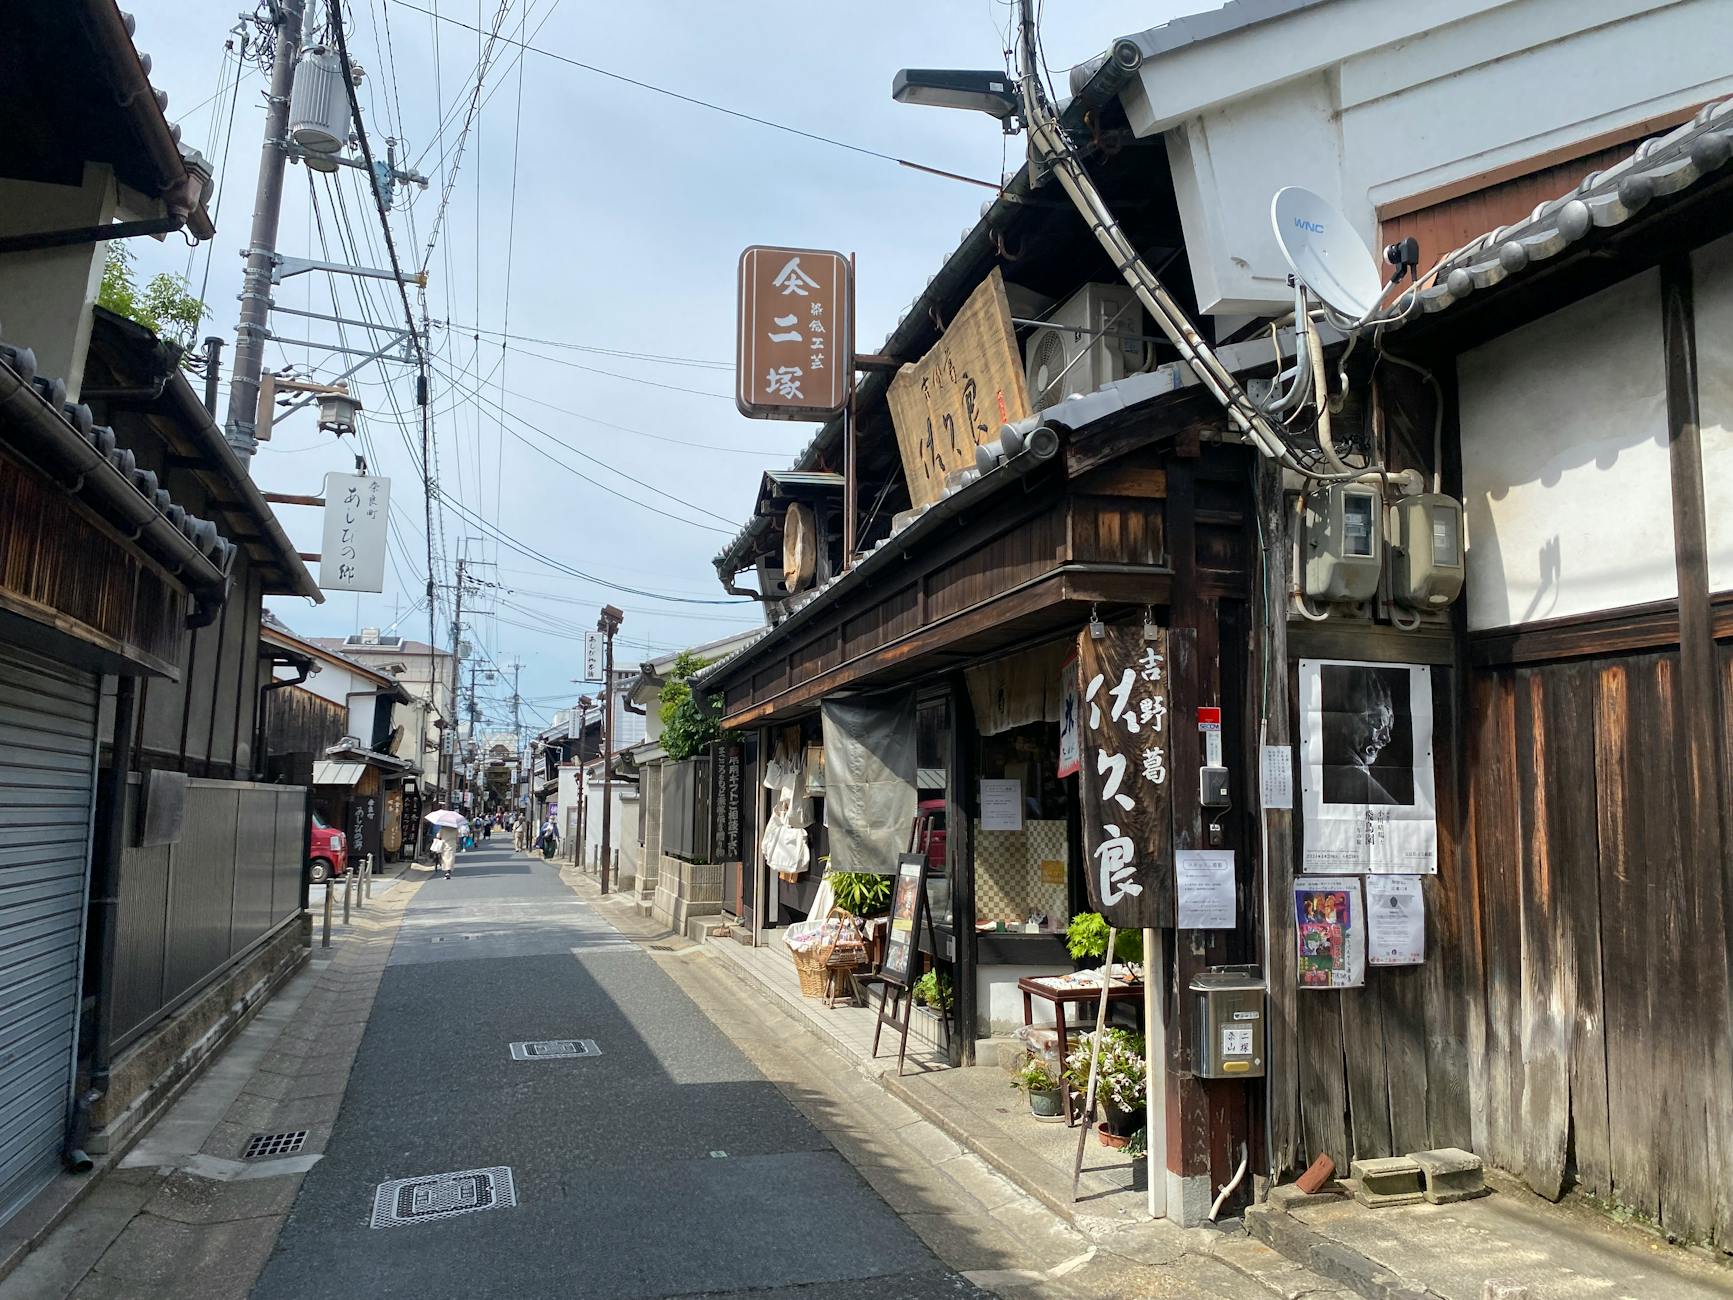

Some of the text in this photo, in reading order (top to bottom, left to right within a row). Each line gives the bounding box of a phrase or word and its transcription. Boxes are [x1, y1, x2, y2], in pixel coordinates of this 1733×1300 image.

[1294, 217, 1324, 234] WNC
[765, 313, 805, 401] 二塚
[366, 481, 382, 521] 奈良町
[1138, 646, 1169, 785] 吉野葛
[1199, 723, 1220, 731] SECOM
[1085, 668, 1144, 908] 佐久良
